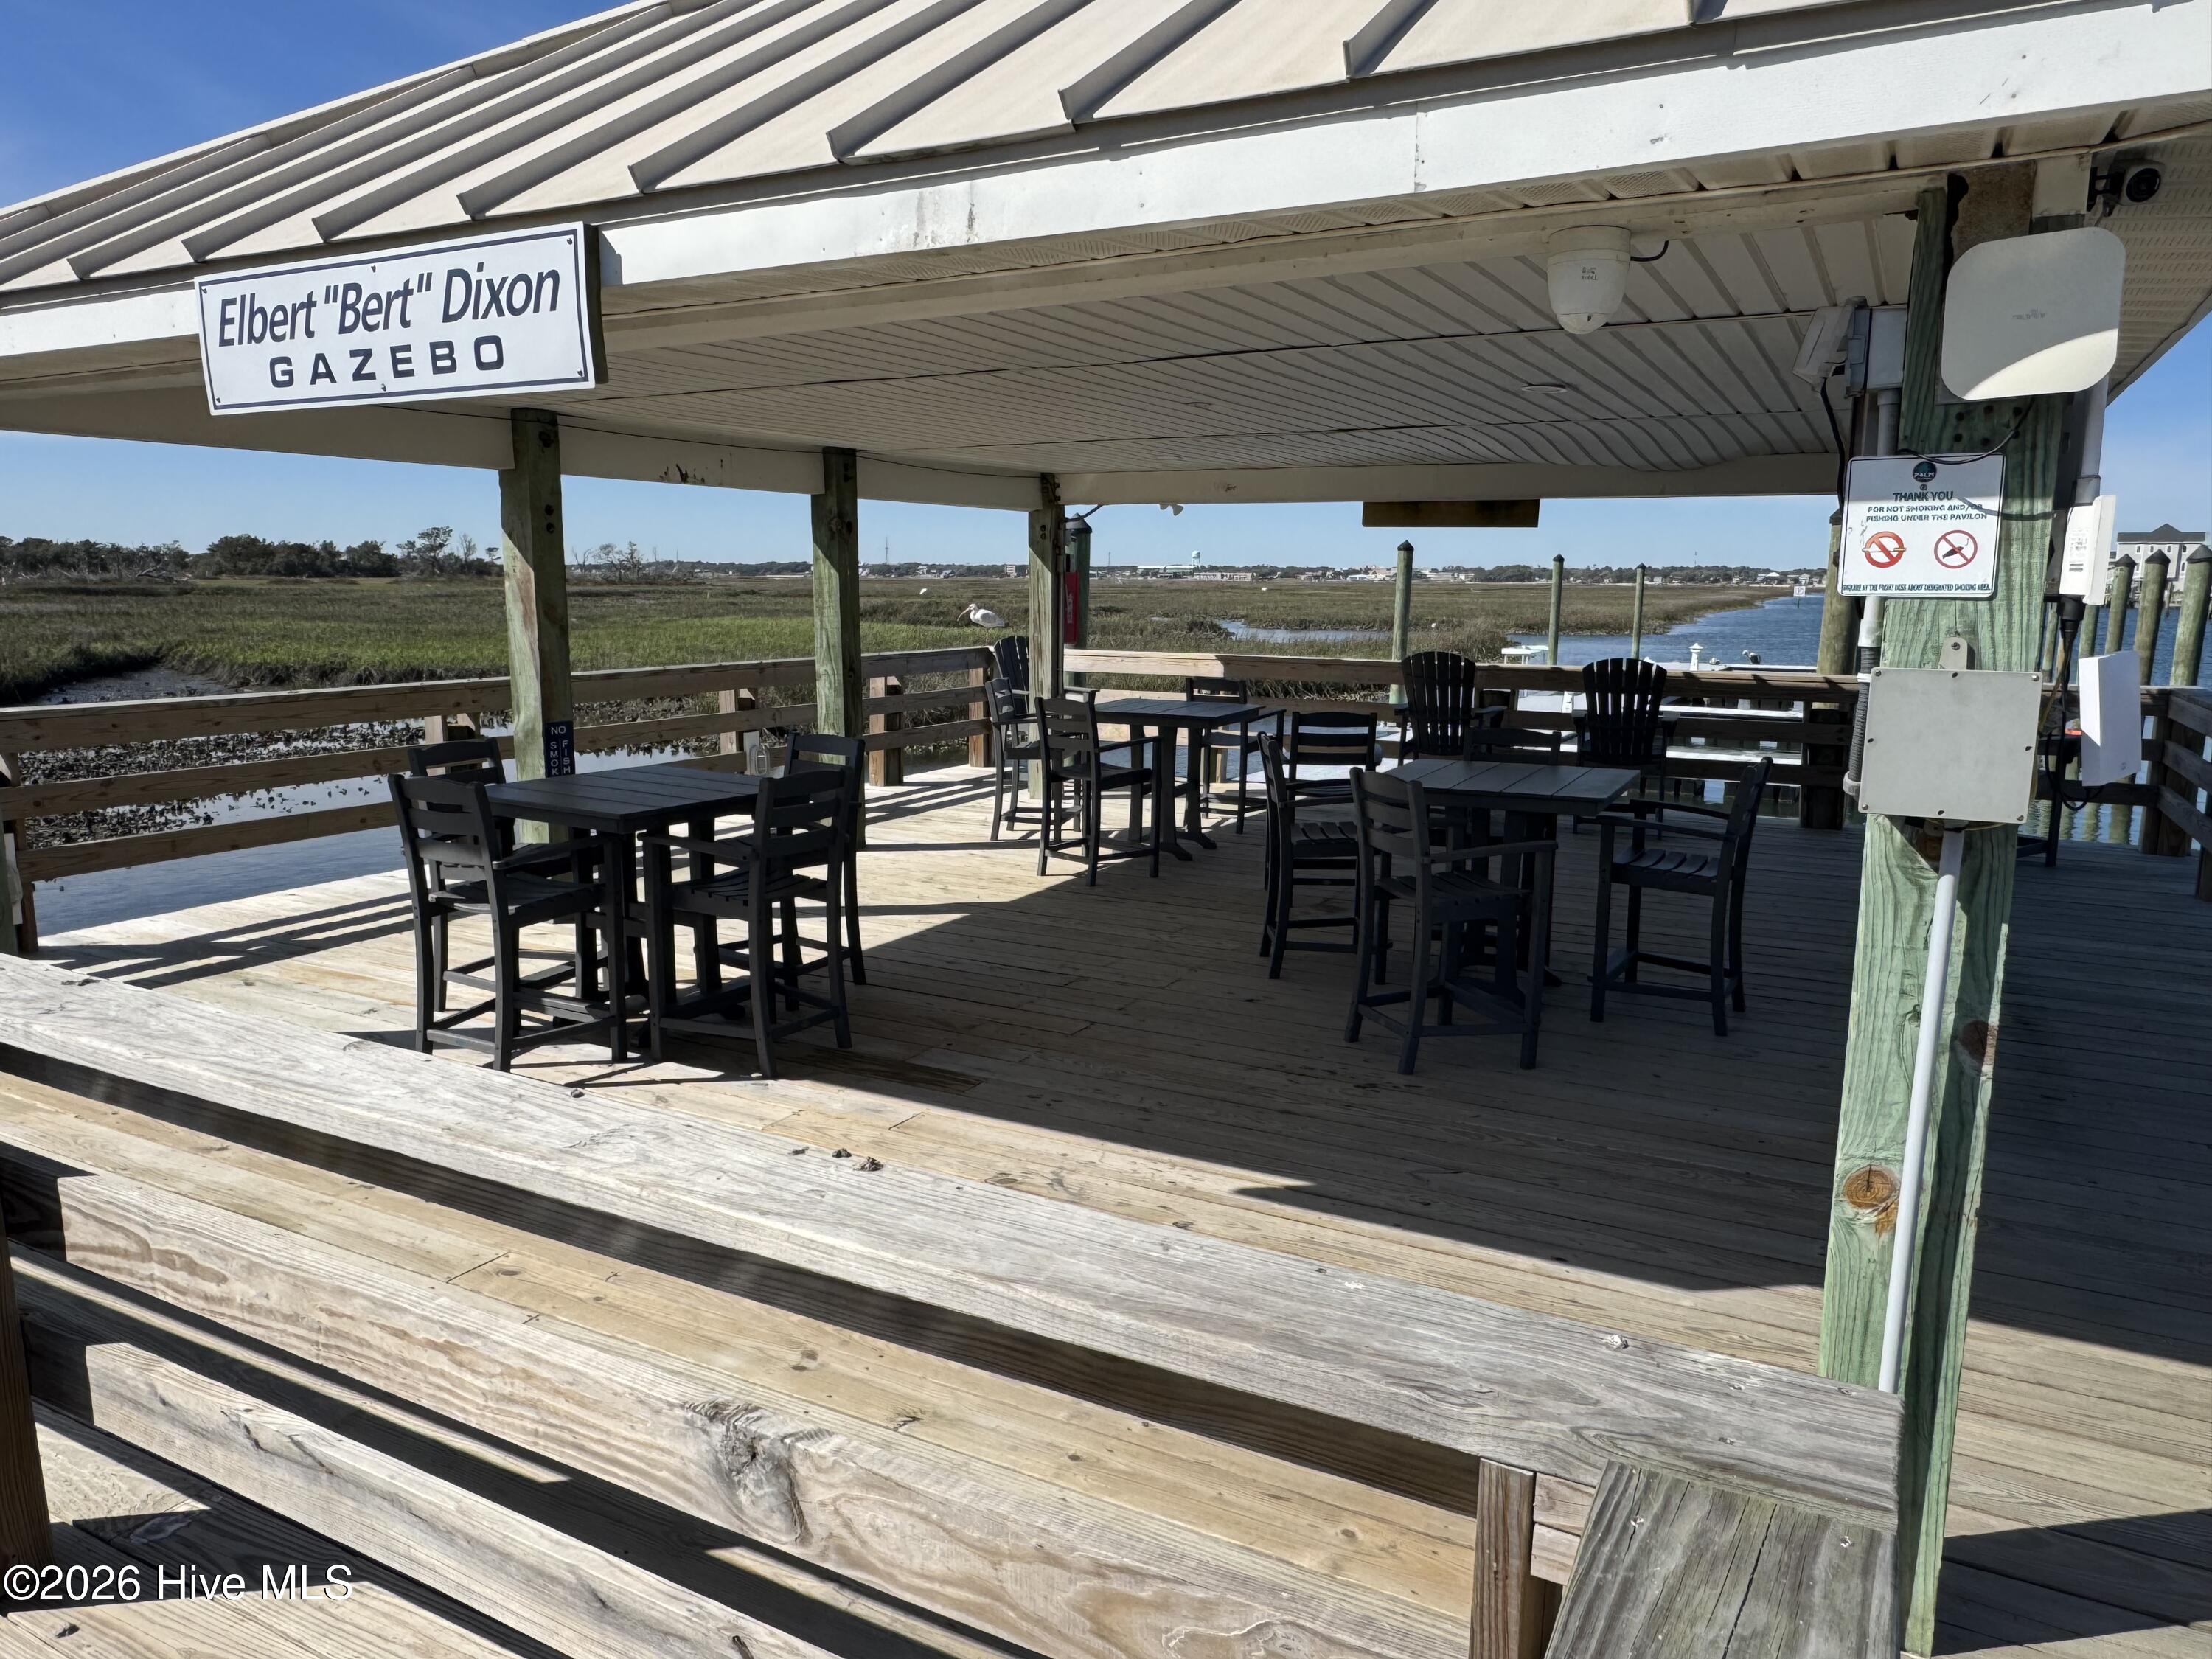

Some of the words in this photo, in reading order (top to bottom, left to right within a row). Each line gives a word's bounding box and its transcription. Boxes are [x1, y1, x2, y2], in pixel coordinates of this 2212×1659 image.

[218, 290, 317, 347] Elbert
[324, 272, 433, 335] "Bert"
[442, 262, 561, 324] Dixon
[269, 335, 504, 389] GAZEBO
[1893, 491, 1930, 501] THANK
[1930, 491, 1954, 501] YOU
[551, 726, 566, 735] NO
